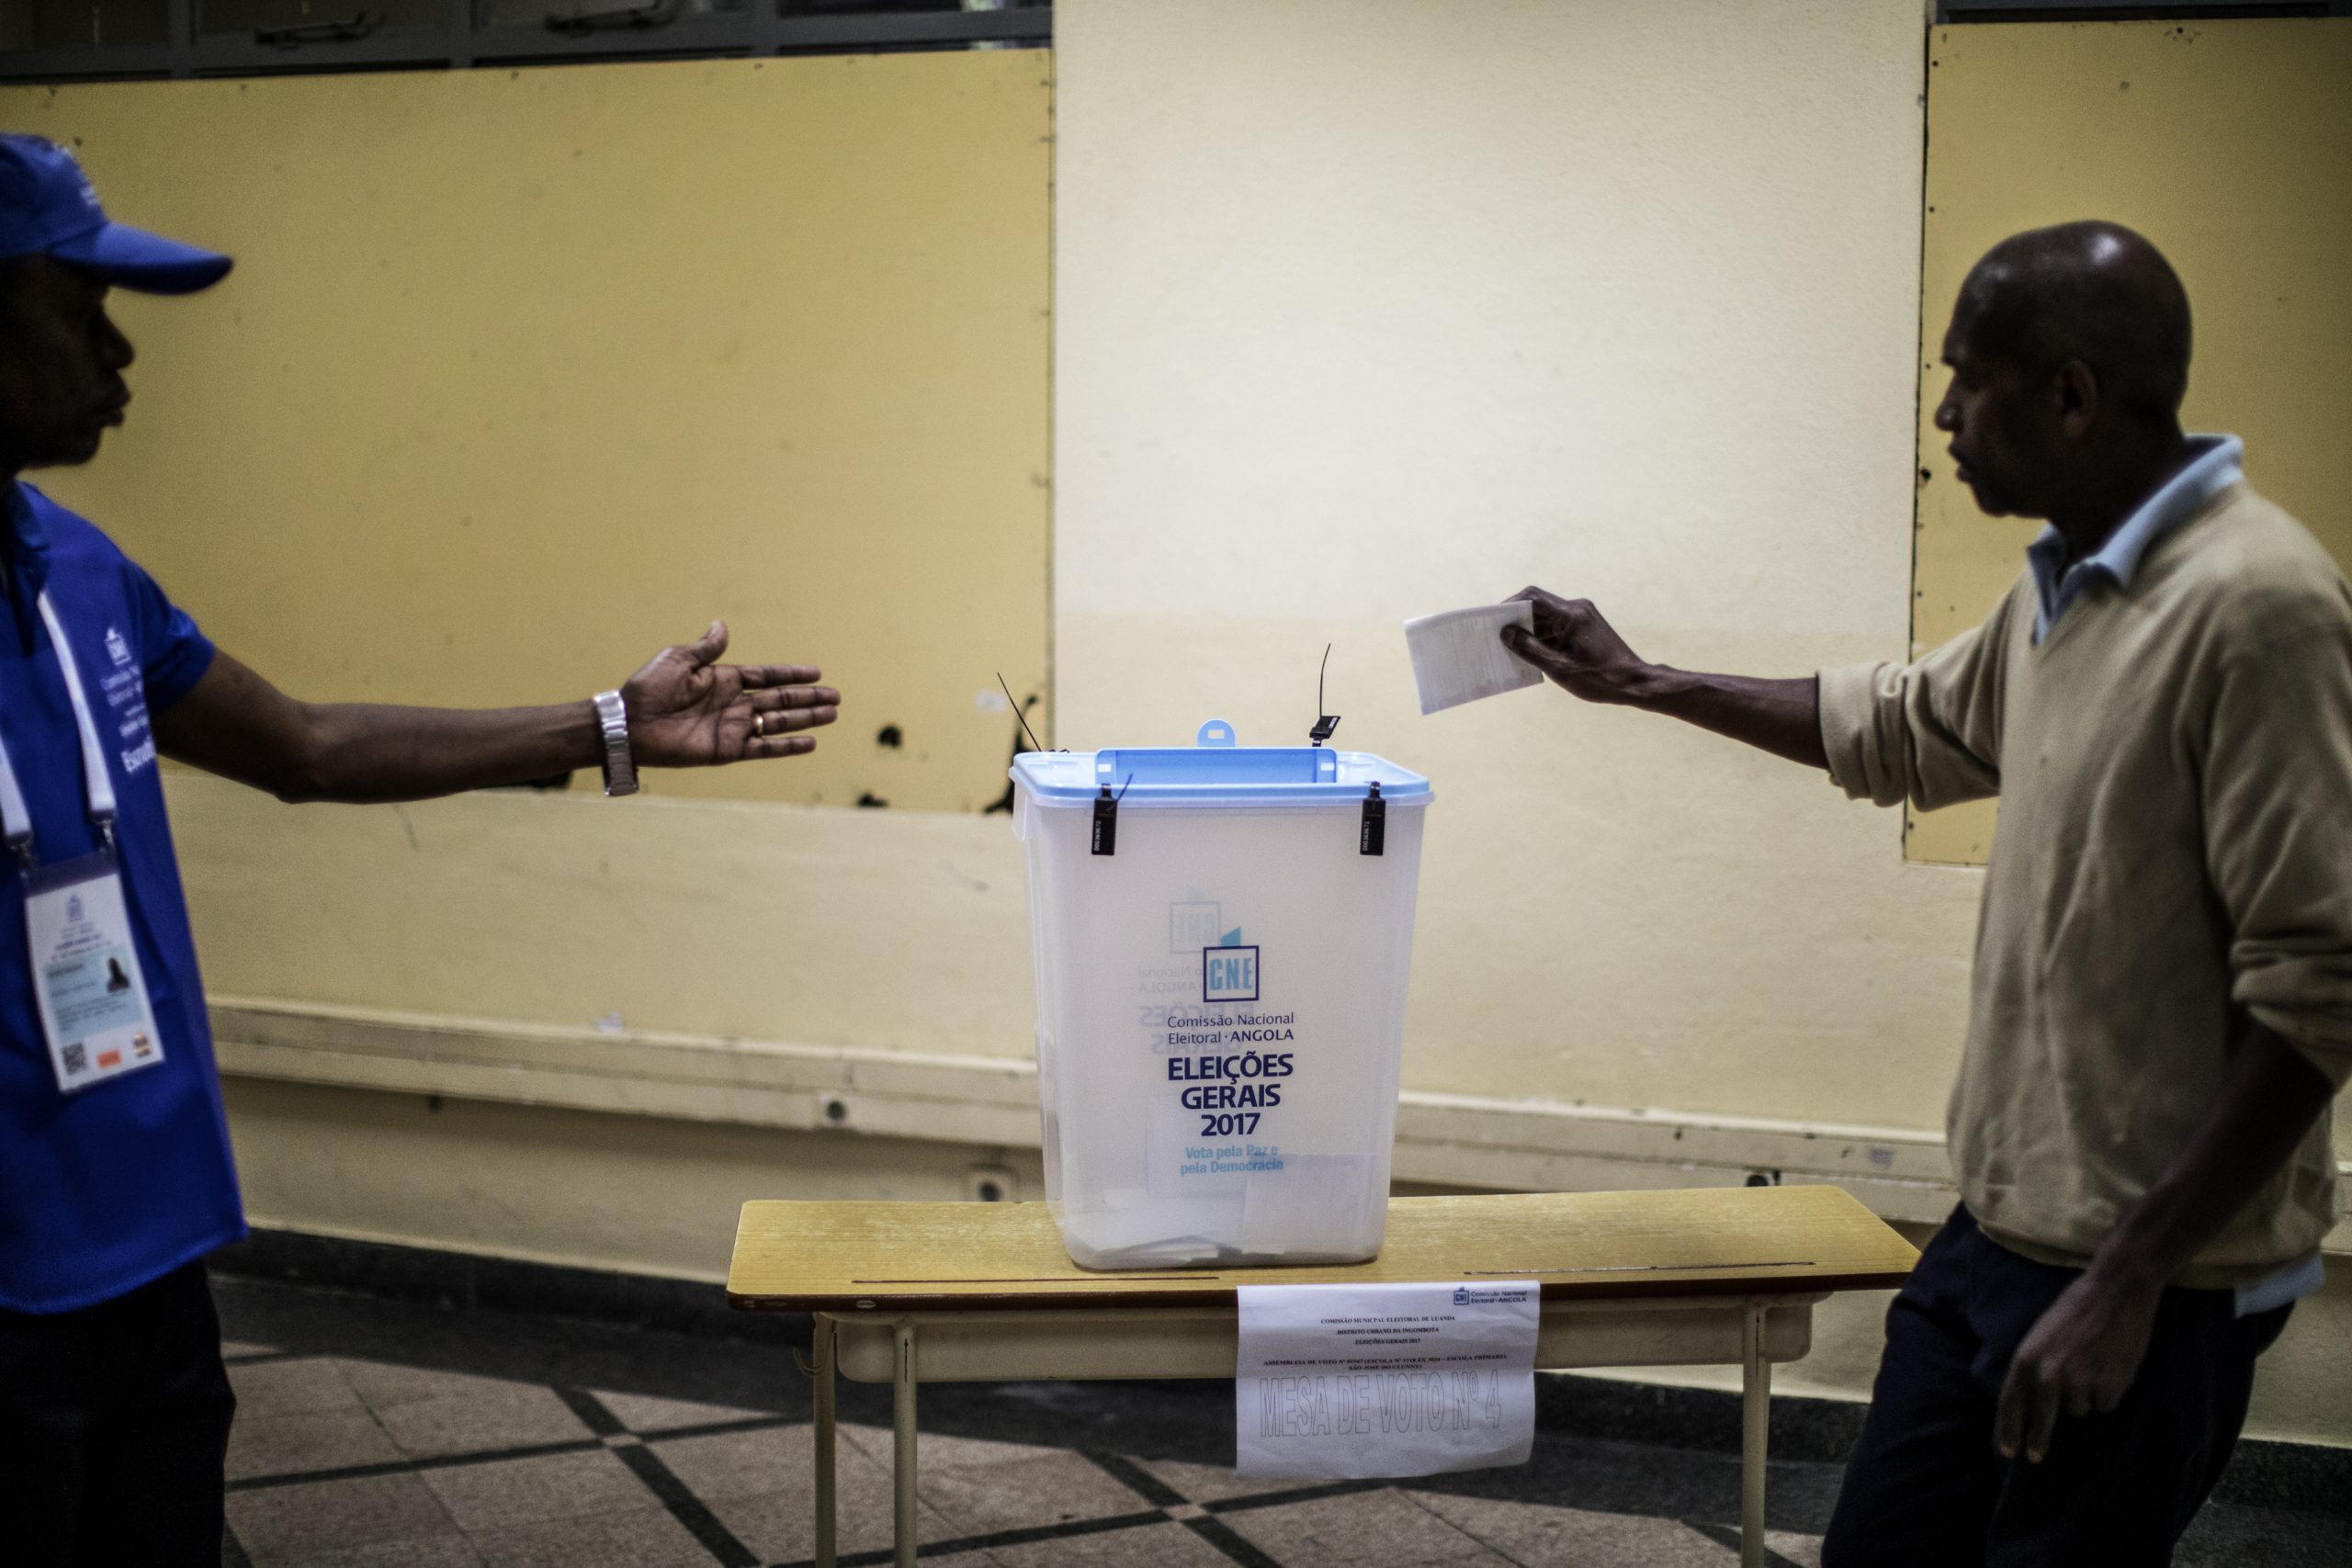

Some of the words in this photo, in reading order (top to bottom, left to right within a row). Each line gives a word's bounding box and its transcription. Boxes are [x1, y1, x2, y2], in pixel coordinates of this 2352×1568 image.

[1209, 957, 1252, 991] CNE
[1167, 1013, 1233, 1029] Comissão
[1238, 1011, 1294, 1025] Nacional
[1168, 1031, 1221, 1044] Eleitoral
[1229, 1029, 1294, 1043] ANGOLA
[1168, 1051, 1294, 1085] ELEIÇÕES
[1181, 1083, 1281, 1110] GERAIS
[1201, 1112, 1261, 1136] 2017
[1185, 1146, 1213, 1158] Vota
[1216, 1145, 1243, 1160] pela
[1247, 1145, 1267, 1156] Paz
[1271, 1145, 1279, 1156] e
[1181, 1161, 1207, 1177] pela
[1211, 1158, 1283, 1173] Democracia
[1355, 1337, 1385, 1346] ELEIÇÕES
[1260, 1376, 1330, 1438] MESA
[1338, 1374, 1370, 1435] DE
[1376, 1372, 1445, 1434] VOTO
[1485, 1369, 1502, 1429] 4
